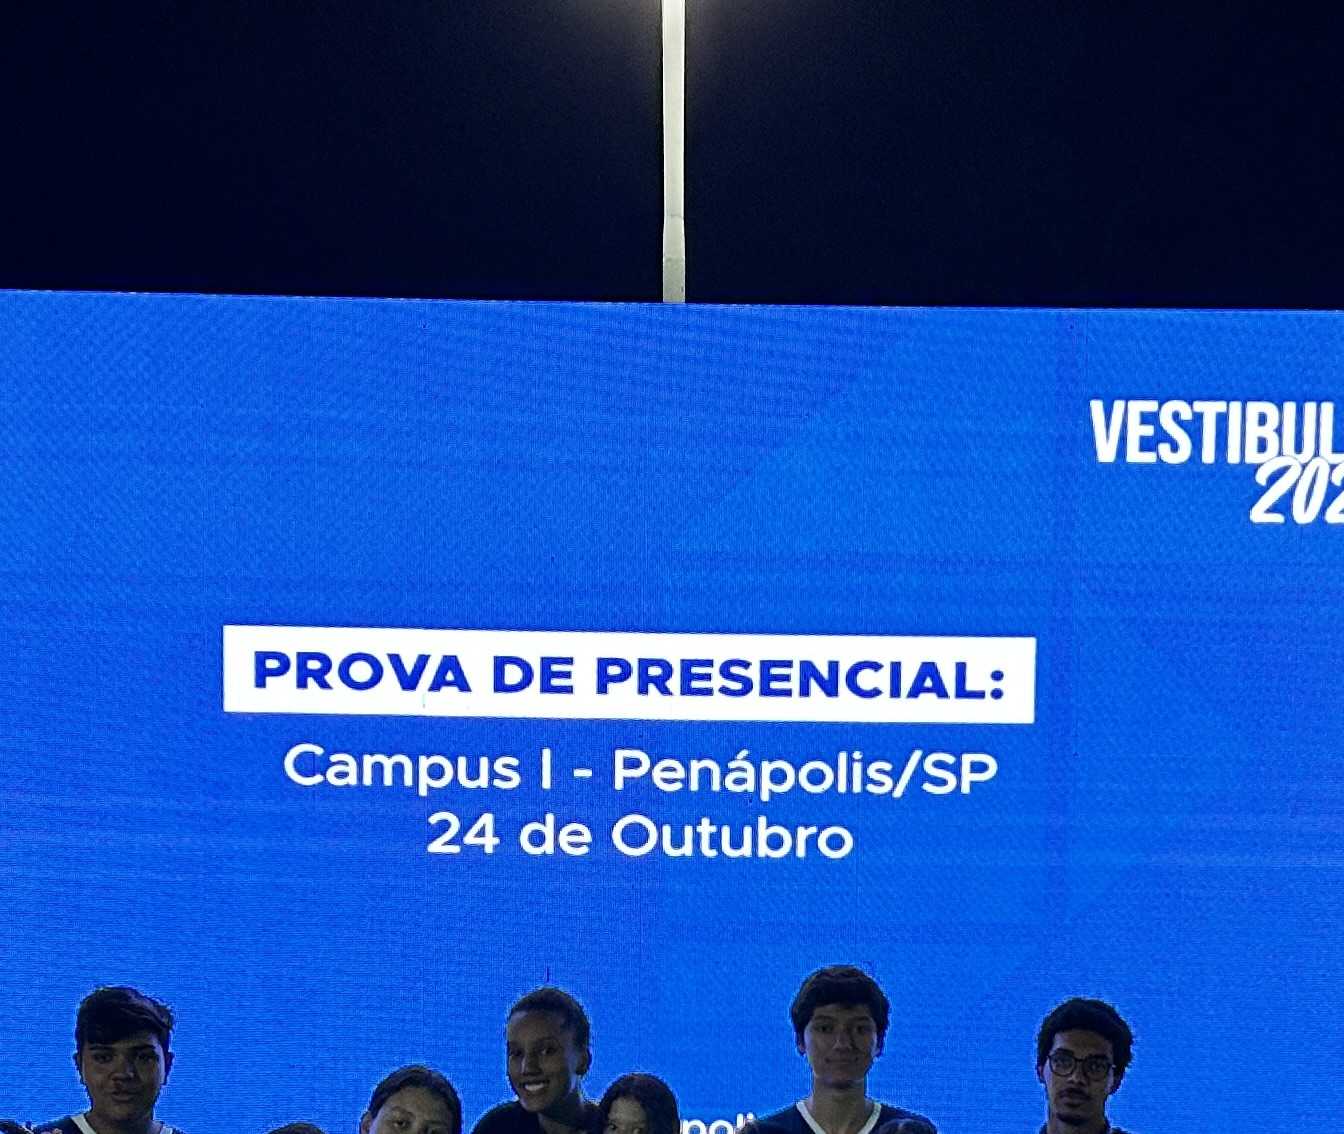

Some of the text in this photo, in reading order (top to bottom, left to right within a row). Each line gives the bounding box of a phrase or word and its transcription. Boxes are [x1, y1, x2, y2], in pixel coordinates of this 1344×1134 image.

[254, 650, 1005, 700] PROVA DE PRESENCIAL:
[283, 743, 521, 798] Campus
[614, 749, 998, 803] Penápolis/SP
[427, 811, 854, 859] 24 de Outubro
